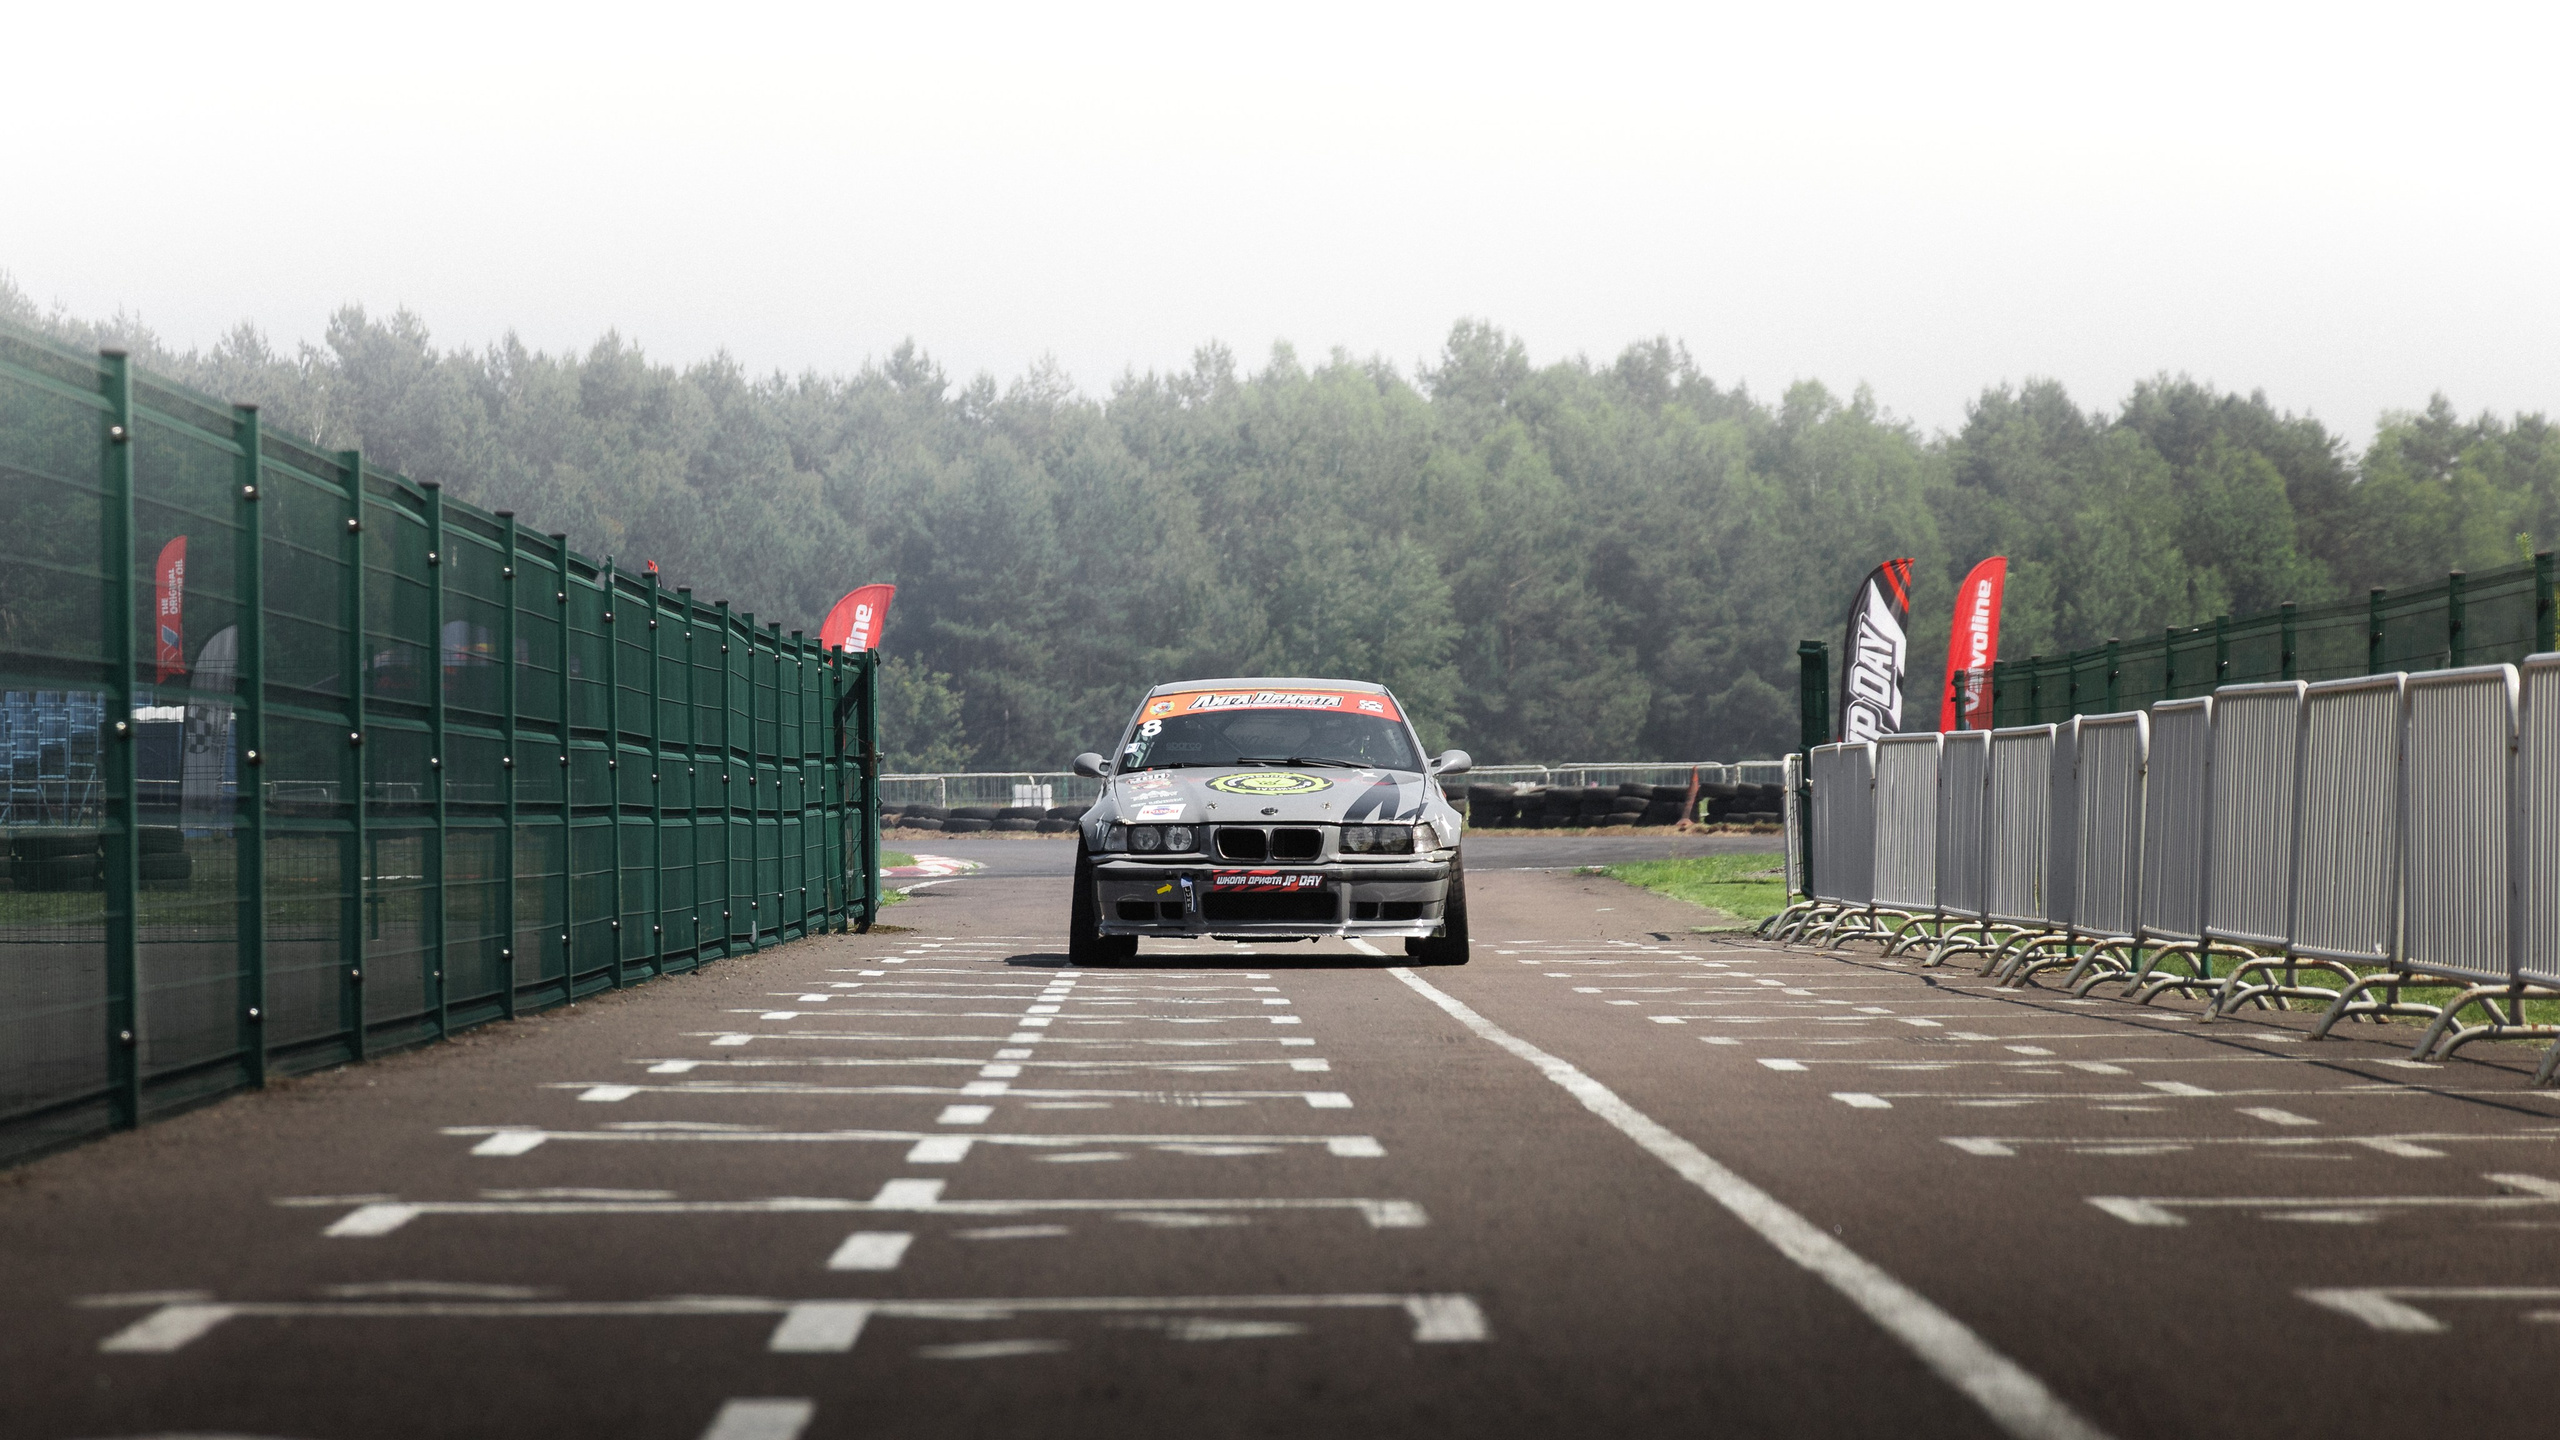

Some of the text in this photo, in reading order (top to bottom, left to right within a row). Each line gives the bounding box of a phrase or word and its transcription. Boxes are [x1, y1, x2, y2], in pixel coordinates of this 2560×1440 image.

[175, 559, 184, 575] OIL
[168, 567, 178, 615] ORIGINAL
[1851, 614, 1897, 709] DAY
[1965, 580, 1991, 712] Valvoline
[1141, 719, 1162, 737] 8
[1216, 875, 1323, 887] ШКОЛА ДРИФТА JP DAY
